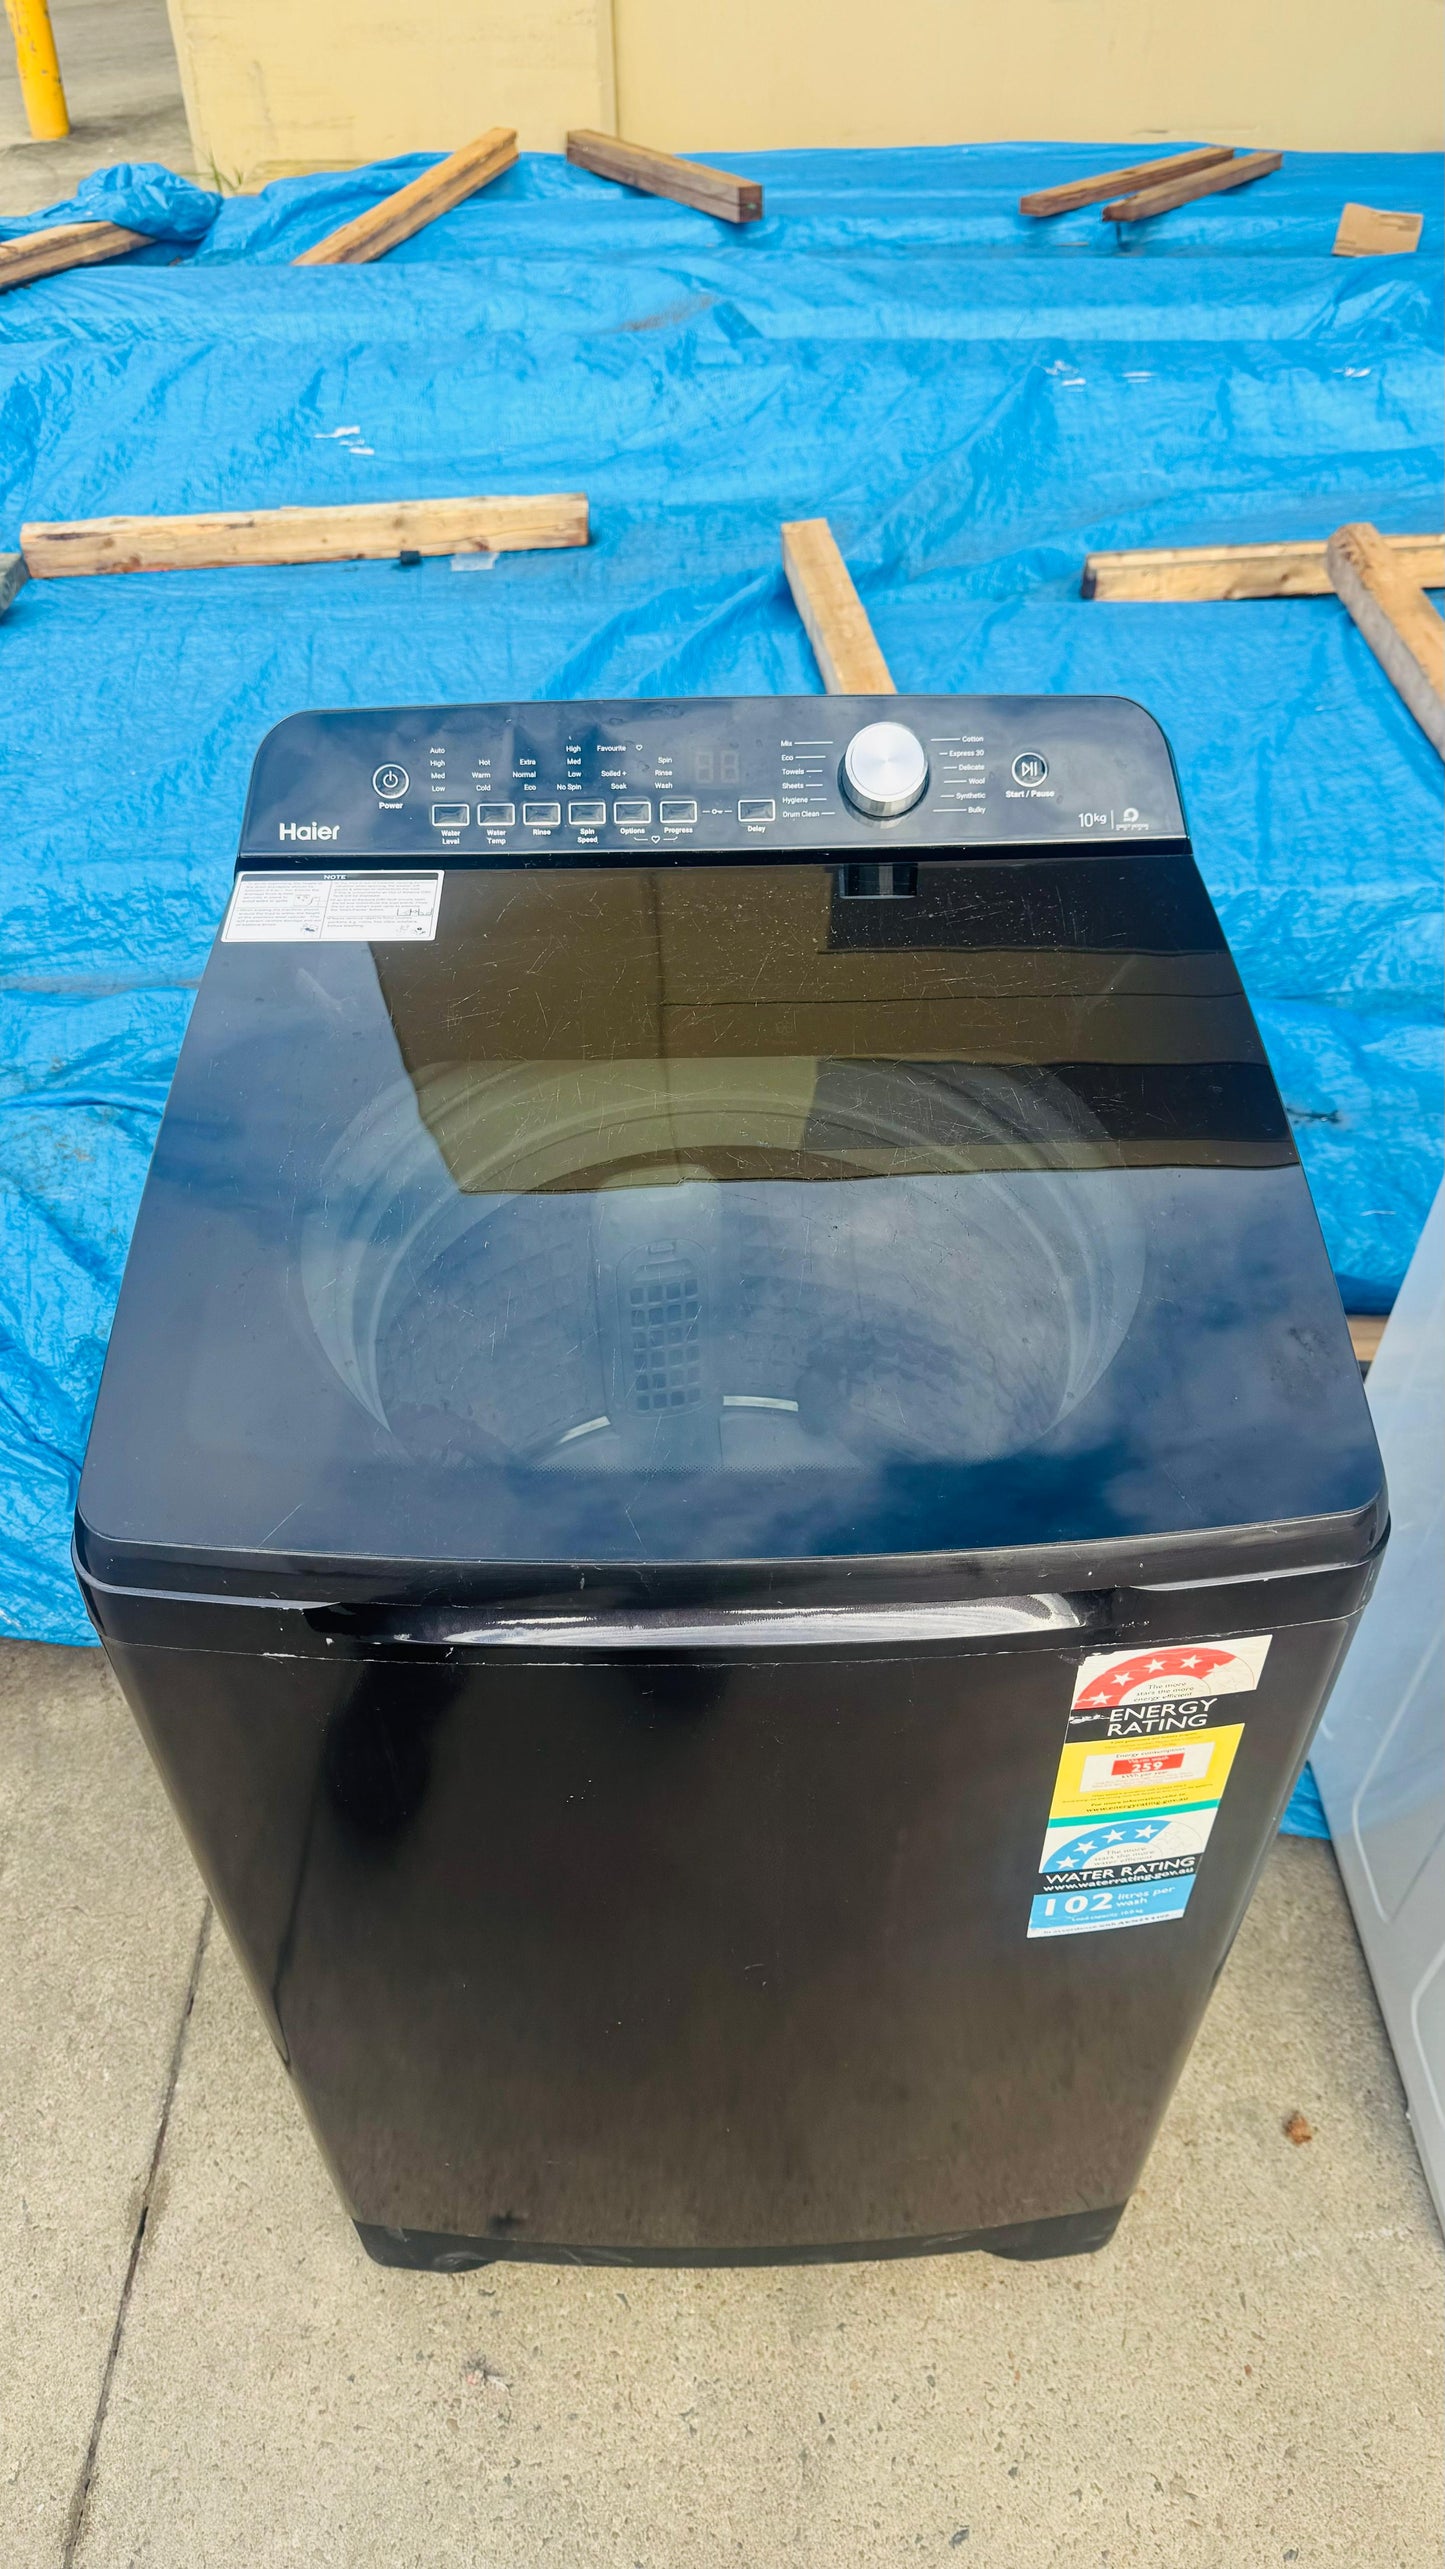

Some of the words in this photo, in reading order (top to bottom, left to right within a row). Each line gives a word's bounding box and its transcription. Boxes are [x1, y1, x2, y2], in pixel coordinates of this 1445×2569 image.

[566, 745, 581, 753] High
[949, 750, 975, 758] Express
[430, 760, 445, 768] High
[658, 756, 673, 764] Spin
[567, 783, 582, 791] Spin
[611, 782, 627, 790] Soak
[1005, 790, 1025, 798] Start
[782, 796, 808, 804] Hygiene
[279, 821, 340, 840] Haier
[620, 827, 645, 835] Options
[1110, 1698, 1218, 1722] ENERGY
[1107, 1714, 1208, 1737] RATING
[1131, 1761, 1163, 1773] 259
[1046, 1869, 1116, 1884] WATER
[1121, 1857, 1196, 1877] RATING
[1043, 1867, 1194, 1892] www.waterrating.gov.au
[1118, 1889, 1150, 1900] litres
[1152, 1886, 1176, 1897] per
[1116, 1898, 1148, 1907] wash
